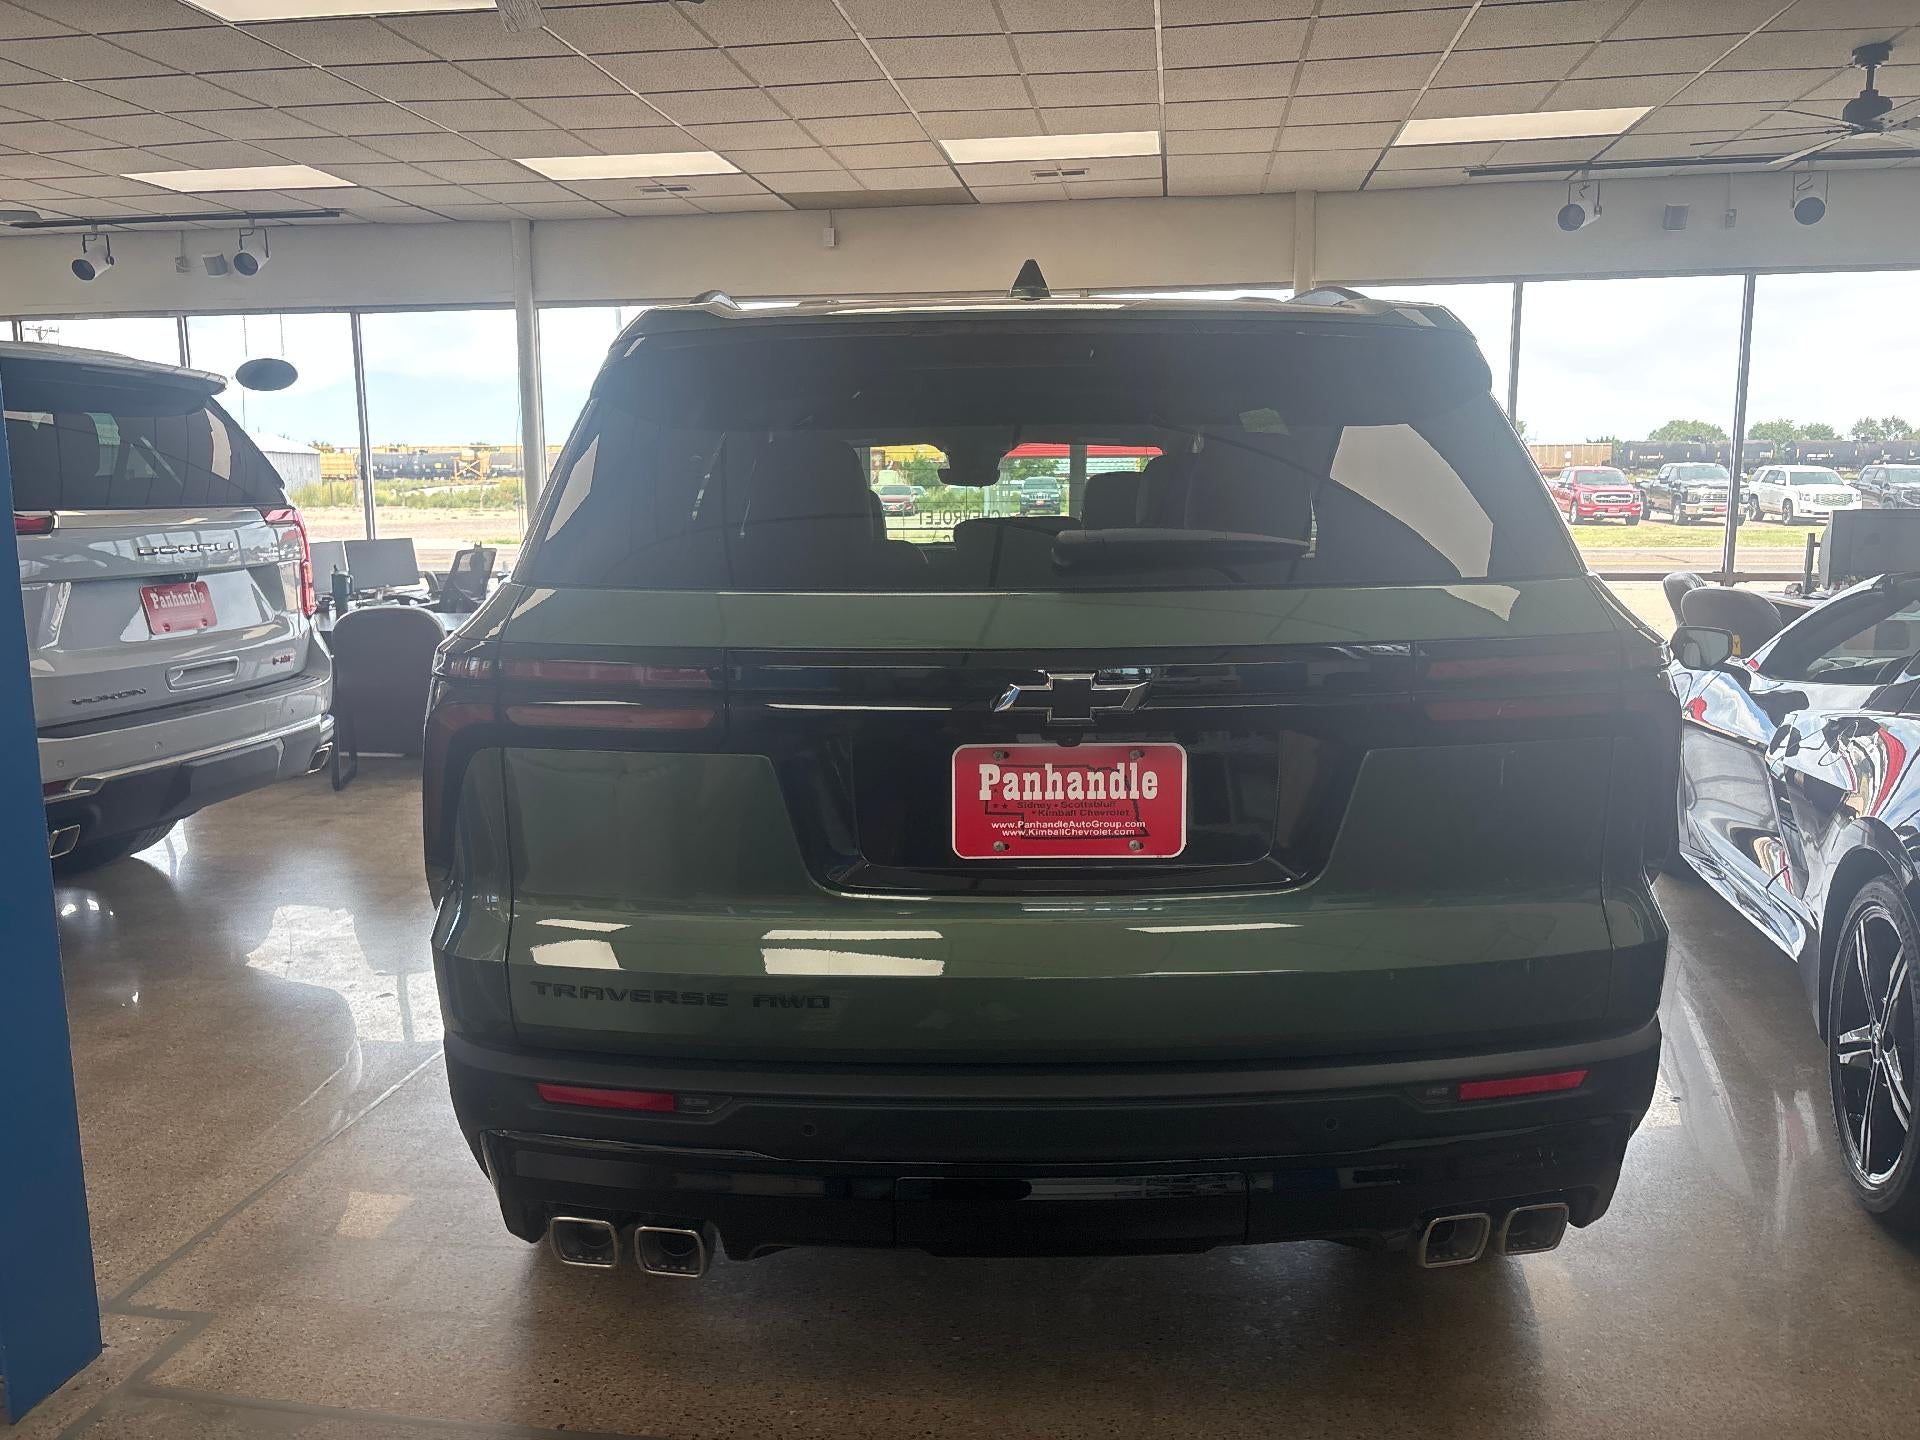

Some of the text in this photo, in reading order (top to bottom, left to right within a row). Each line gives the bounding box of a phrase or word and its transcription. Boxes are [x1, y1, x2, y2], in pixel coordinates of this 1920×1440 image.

[150, 588, 205, 609] Panhandle
[978, 762, 1158, 801] Panhandle
[1016, 801, 1050, 809] Sidney
[1038, 809, 1129, 817] Kimball Chevrolet
[991, 820, 1146, 829] www.PanhandleAutoGroup.com
[1002, 828, 1135, 837] www.KimballChevrolet.com
[530, 980, 832, 1009] TRAVERSE AWD
